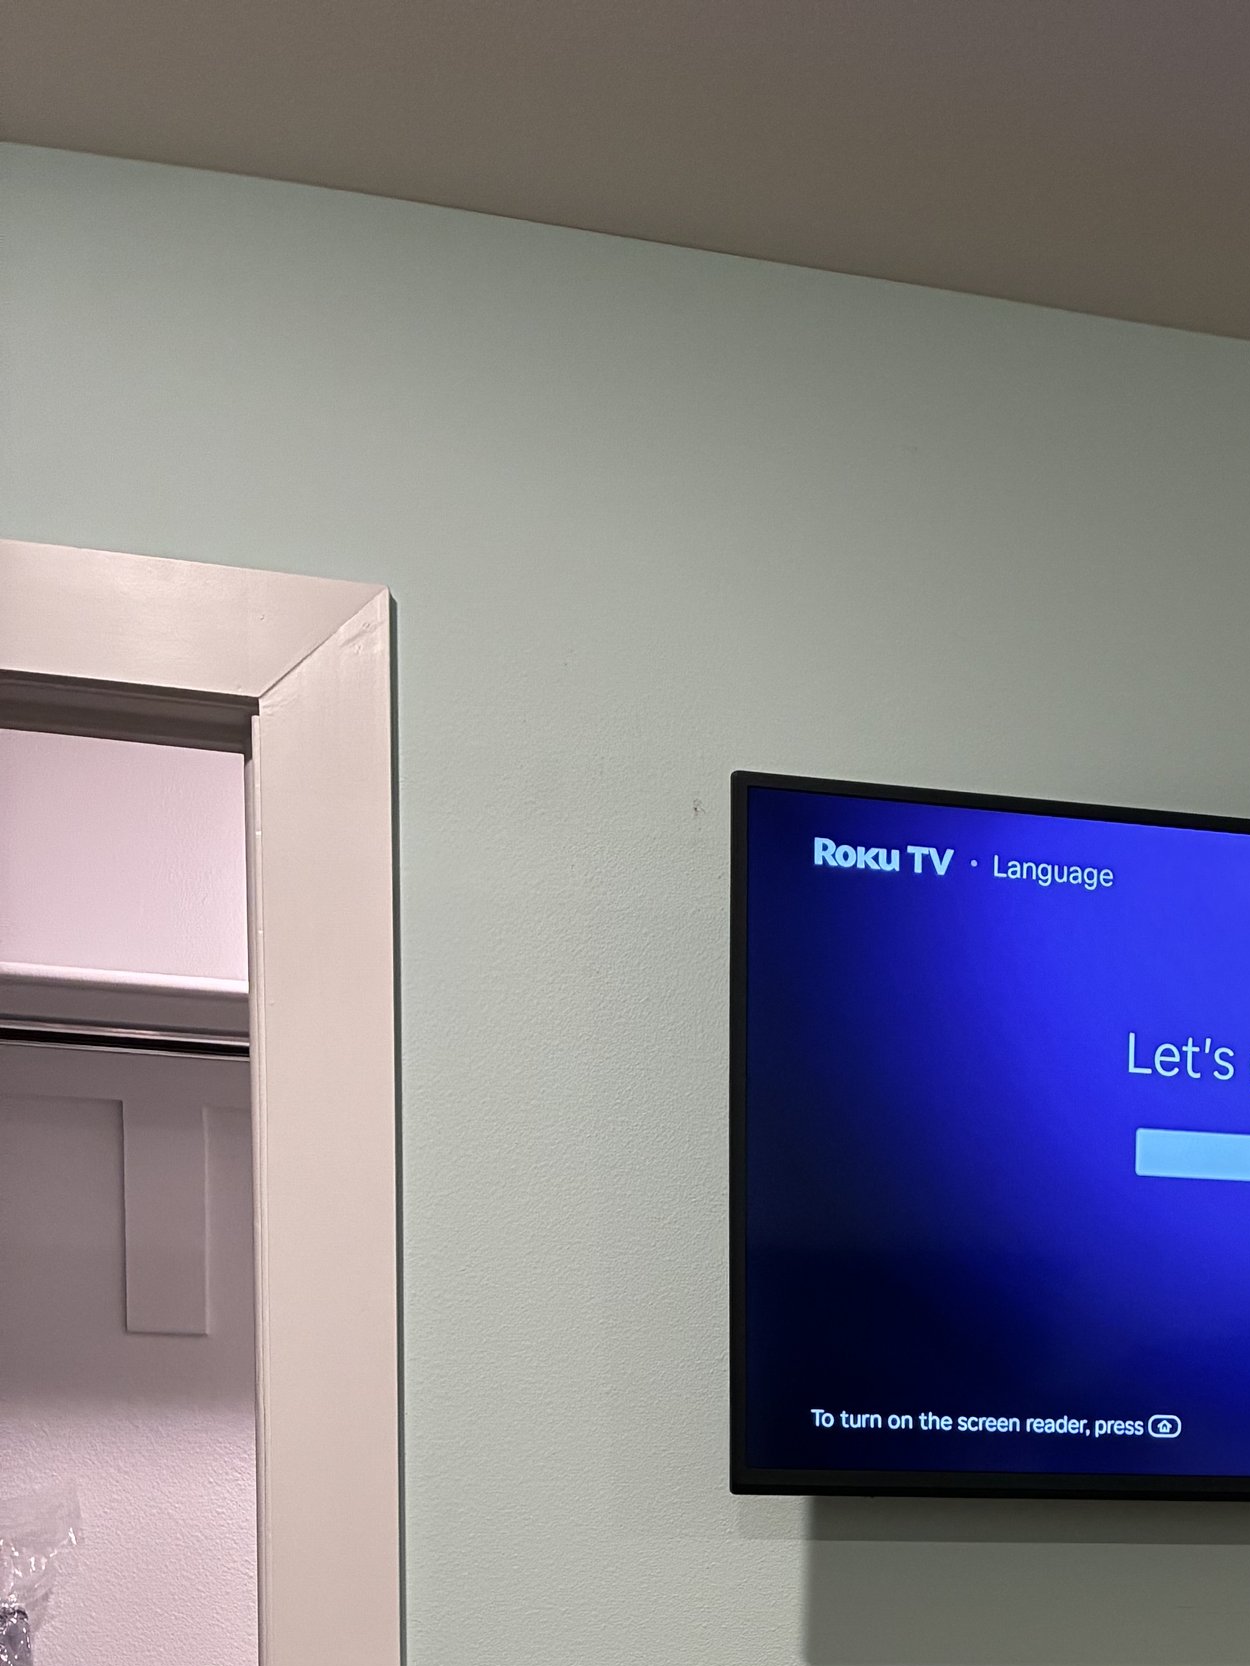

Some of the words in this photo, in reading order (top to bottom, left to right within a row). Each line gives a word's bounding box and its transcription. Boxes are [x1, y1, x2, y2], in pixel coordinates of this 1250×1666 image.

[905, 844, 956, 877] TV
[992, 853, 1115, 892] Language
[1126, 1031, 1236, 1082] Let's
[809, 1407, 836, 1429] To
[839, 1409, 883, 1430] turn
[886, 1413, 914, 1431] on
[917, 1410, 954, 1432] the
[956, 1414, 1022, 1434] screen
[1024, 1413, 1091, 1437] reader,
[1093, 1416, 1145, 1439] press
